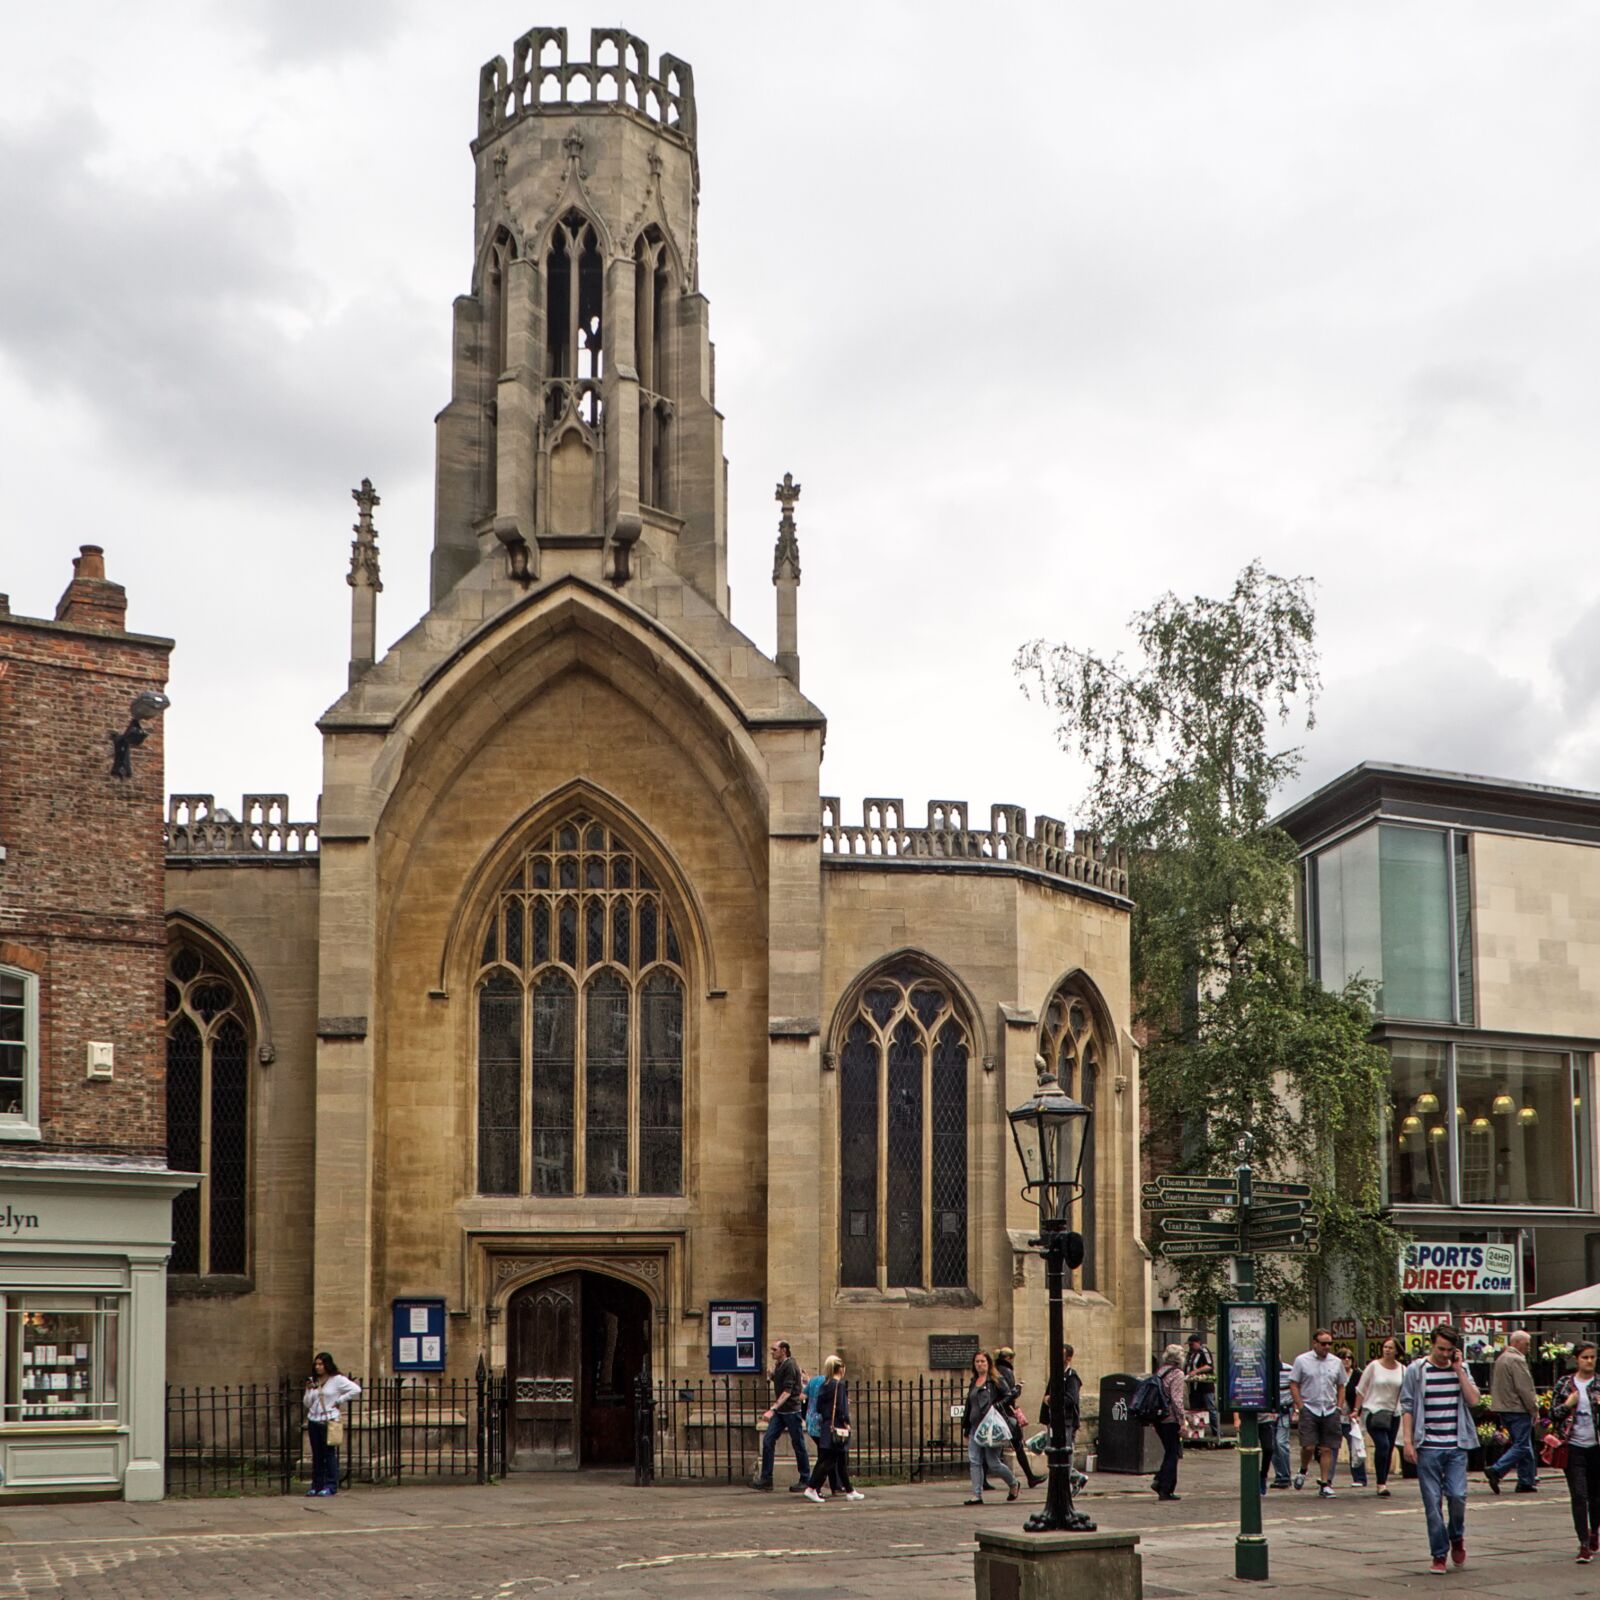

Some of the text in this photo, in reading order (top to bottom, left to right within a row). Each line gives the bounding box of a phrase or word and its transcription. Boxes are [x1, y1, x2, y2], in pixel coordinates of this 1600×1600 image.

[1188, 1179, 1208, 1189] Royal
[1165, 1193, 1223, 1203] Tourist Information
[1168, 1221, 1202, 1231] Taxi Rank
[1166, 1242, 1220, 1253] Assembly Rooms
[1405, 1245, 1483, 1267] SPORTS
[1489, 1252, 1510, 1263] 24HR
[1332, 1320, 1356, 1338] SALE
[1367, 1319, 1391, 1337] SALE
[1409, 1316, 1448, 1334] SALE
[1464, 1317, 1504, 1333] SALE
